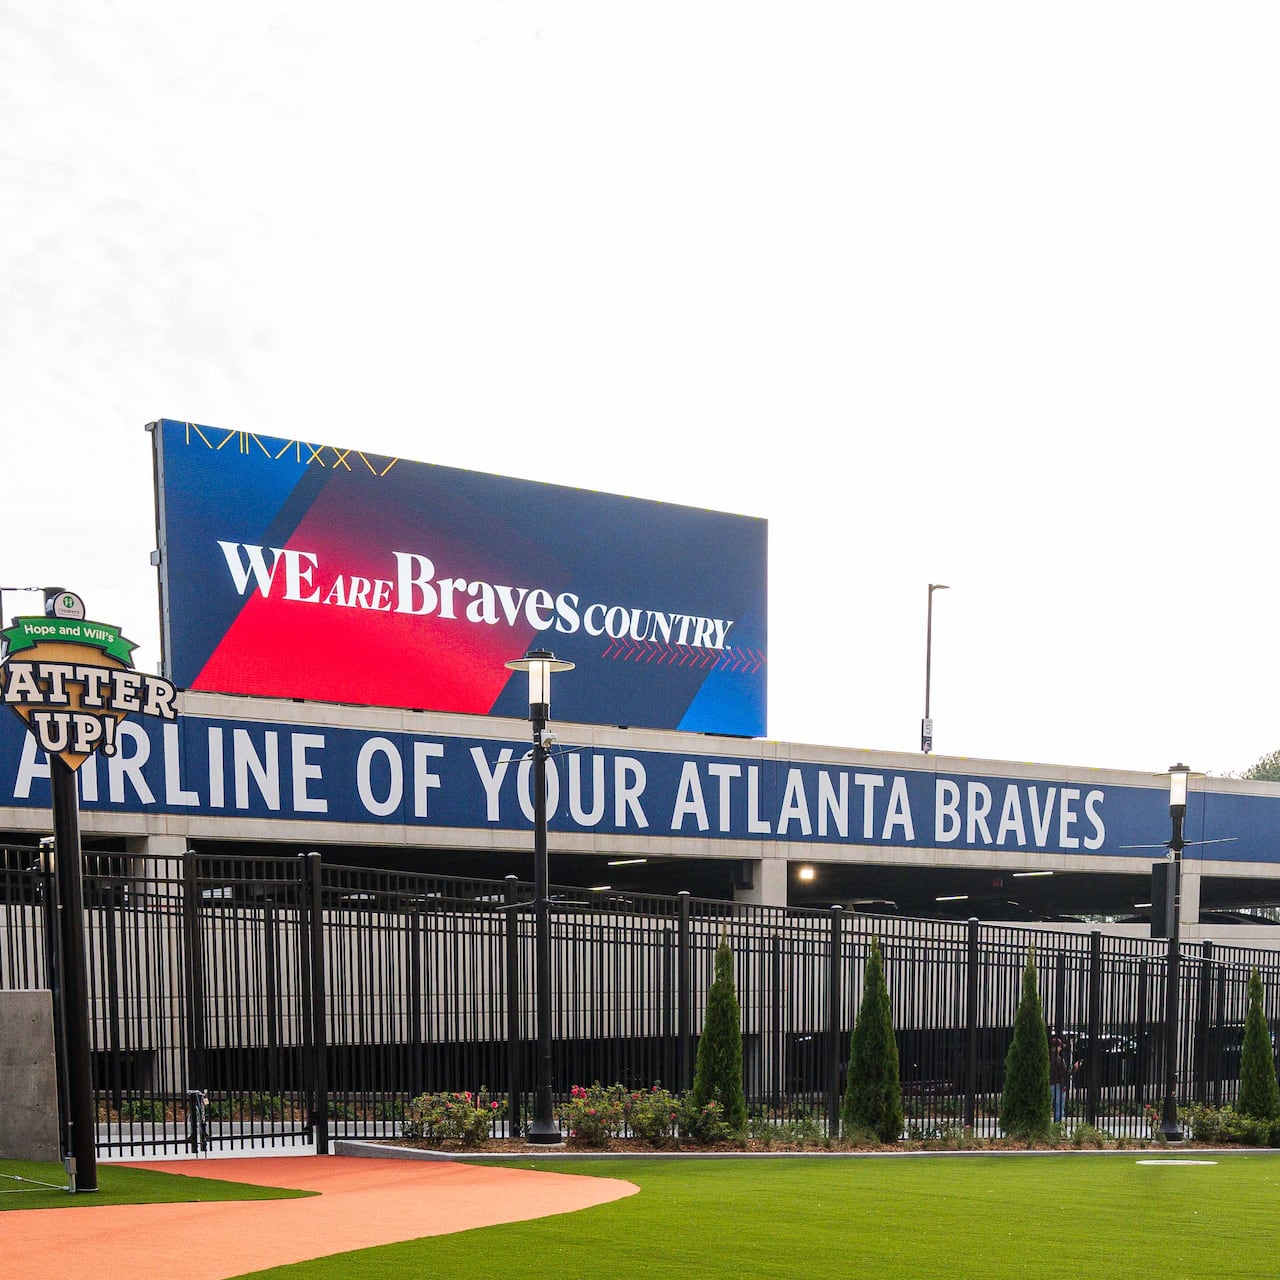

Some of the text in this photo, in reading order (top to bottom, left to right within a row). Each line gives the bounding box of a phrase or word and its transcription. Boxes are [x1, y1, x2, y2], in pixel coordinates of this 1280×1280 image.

[217, 540, 320, 604] WE
[322, 574, 394, 612] ARE
[392, 550, 581, 634] Braves
[24, 624, 114, 643] Hope and Will's
[33, 711, 118, 756] UP!
[356, 736, 445, 818] OF
[470, 747, 650, 829] YOUR
[670, 761, 915, 841] ATLANTA
[934, 778, 1106, 851] BRAVES
